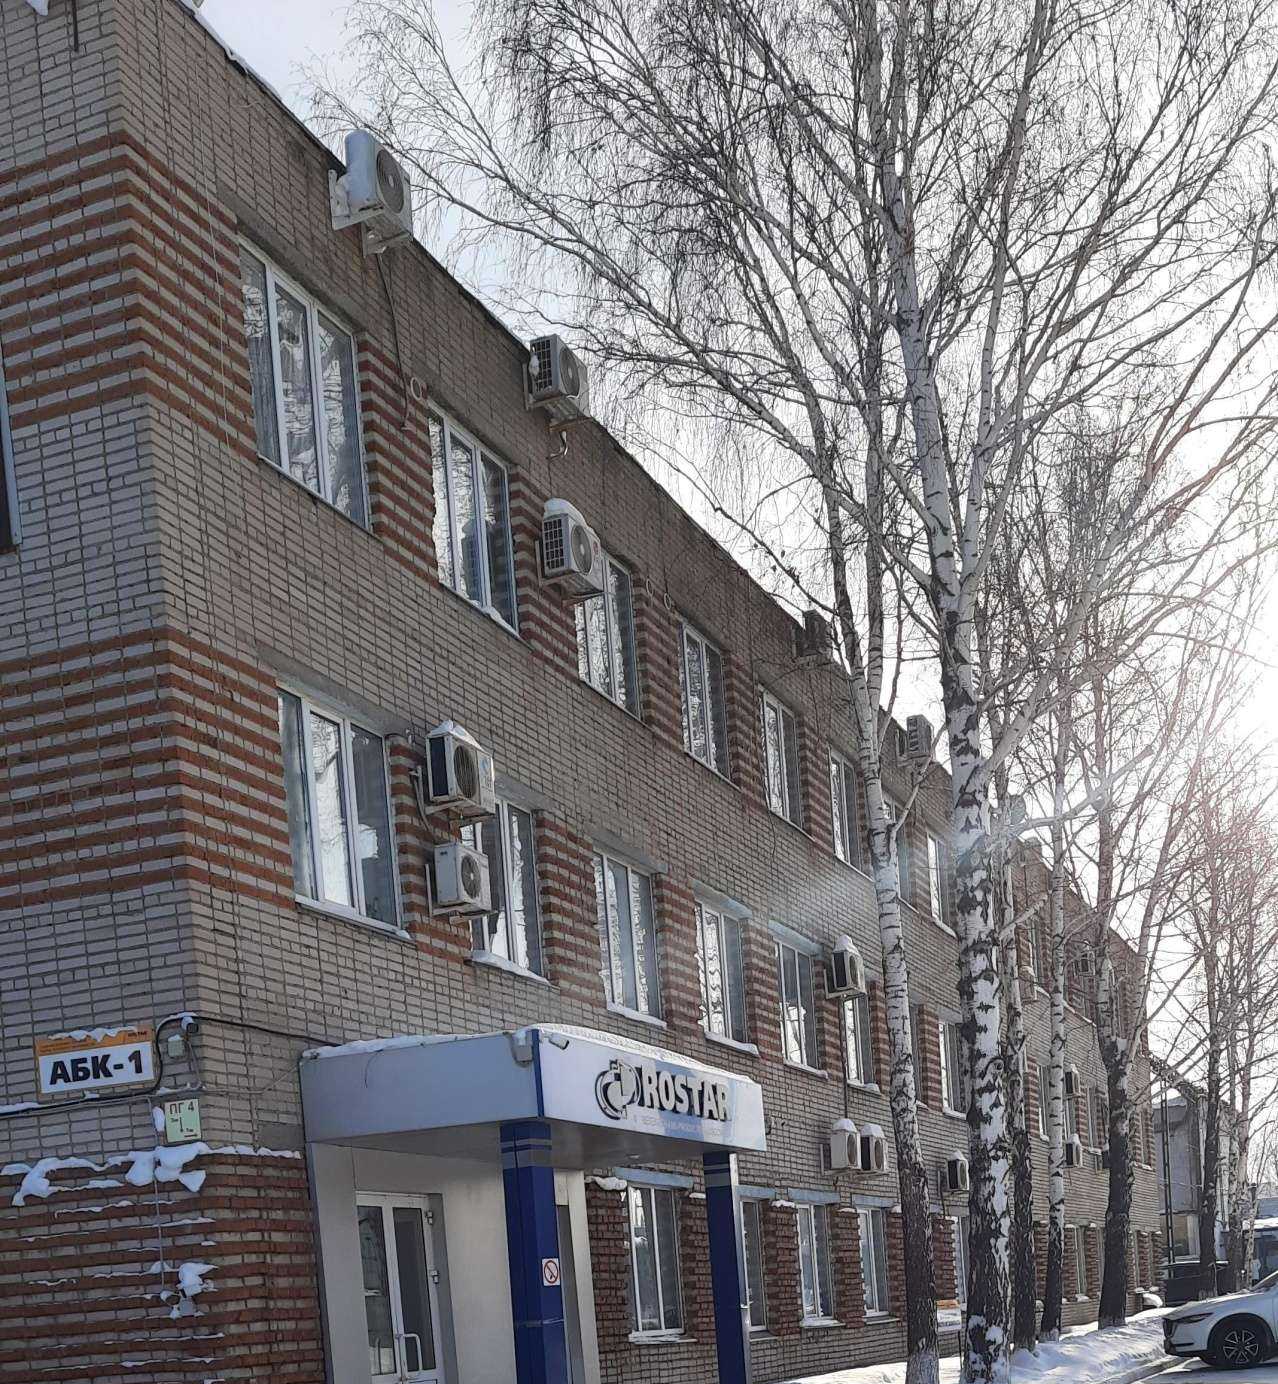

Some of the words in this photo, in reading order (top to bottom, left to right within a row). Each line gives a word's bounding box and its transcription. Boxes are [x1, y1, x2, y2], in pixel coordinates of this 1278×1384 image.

[50, 1050, 143, 1085] АБК-1
[169, 1102, 184, 1115] ПГ
[188, 1101, 194, 1111] 4
[638, 1065, 731, 1121] ROSTAR
